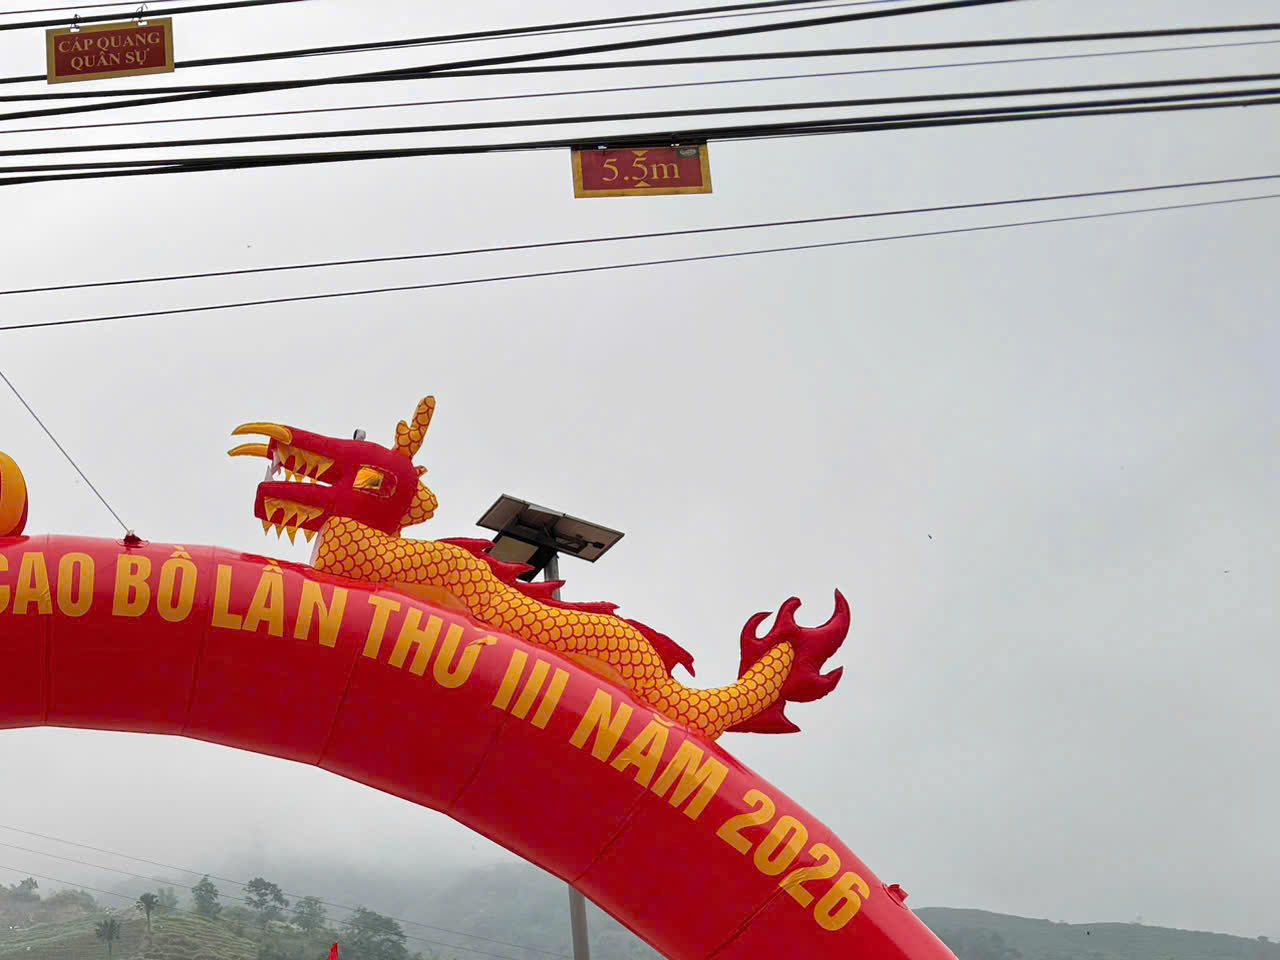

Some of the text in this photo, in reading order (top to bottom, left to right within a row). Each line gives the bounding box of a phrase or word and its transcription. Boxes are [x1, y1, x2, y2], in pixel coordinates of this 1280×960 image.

[58, 32, 160, 53] CÁP QUANG
[71, 47, 150, 71] QUÂN SỰ
[602, 157, 680, 181] 5.5m
[491, 648, 570, 730] III
[569, 688, 729, 821] NĂM
[715, 789, 871, 931] 2026
